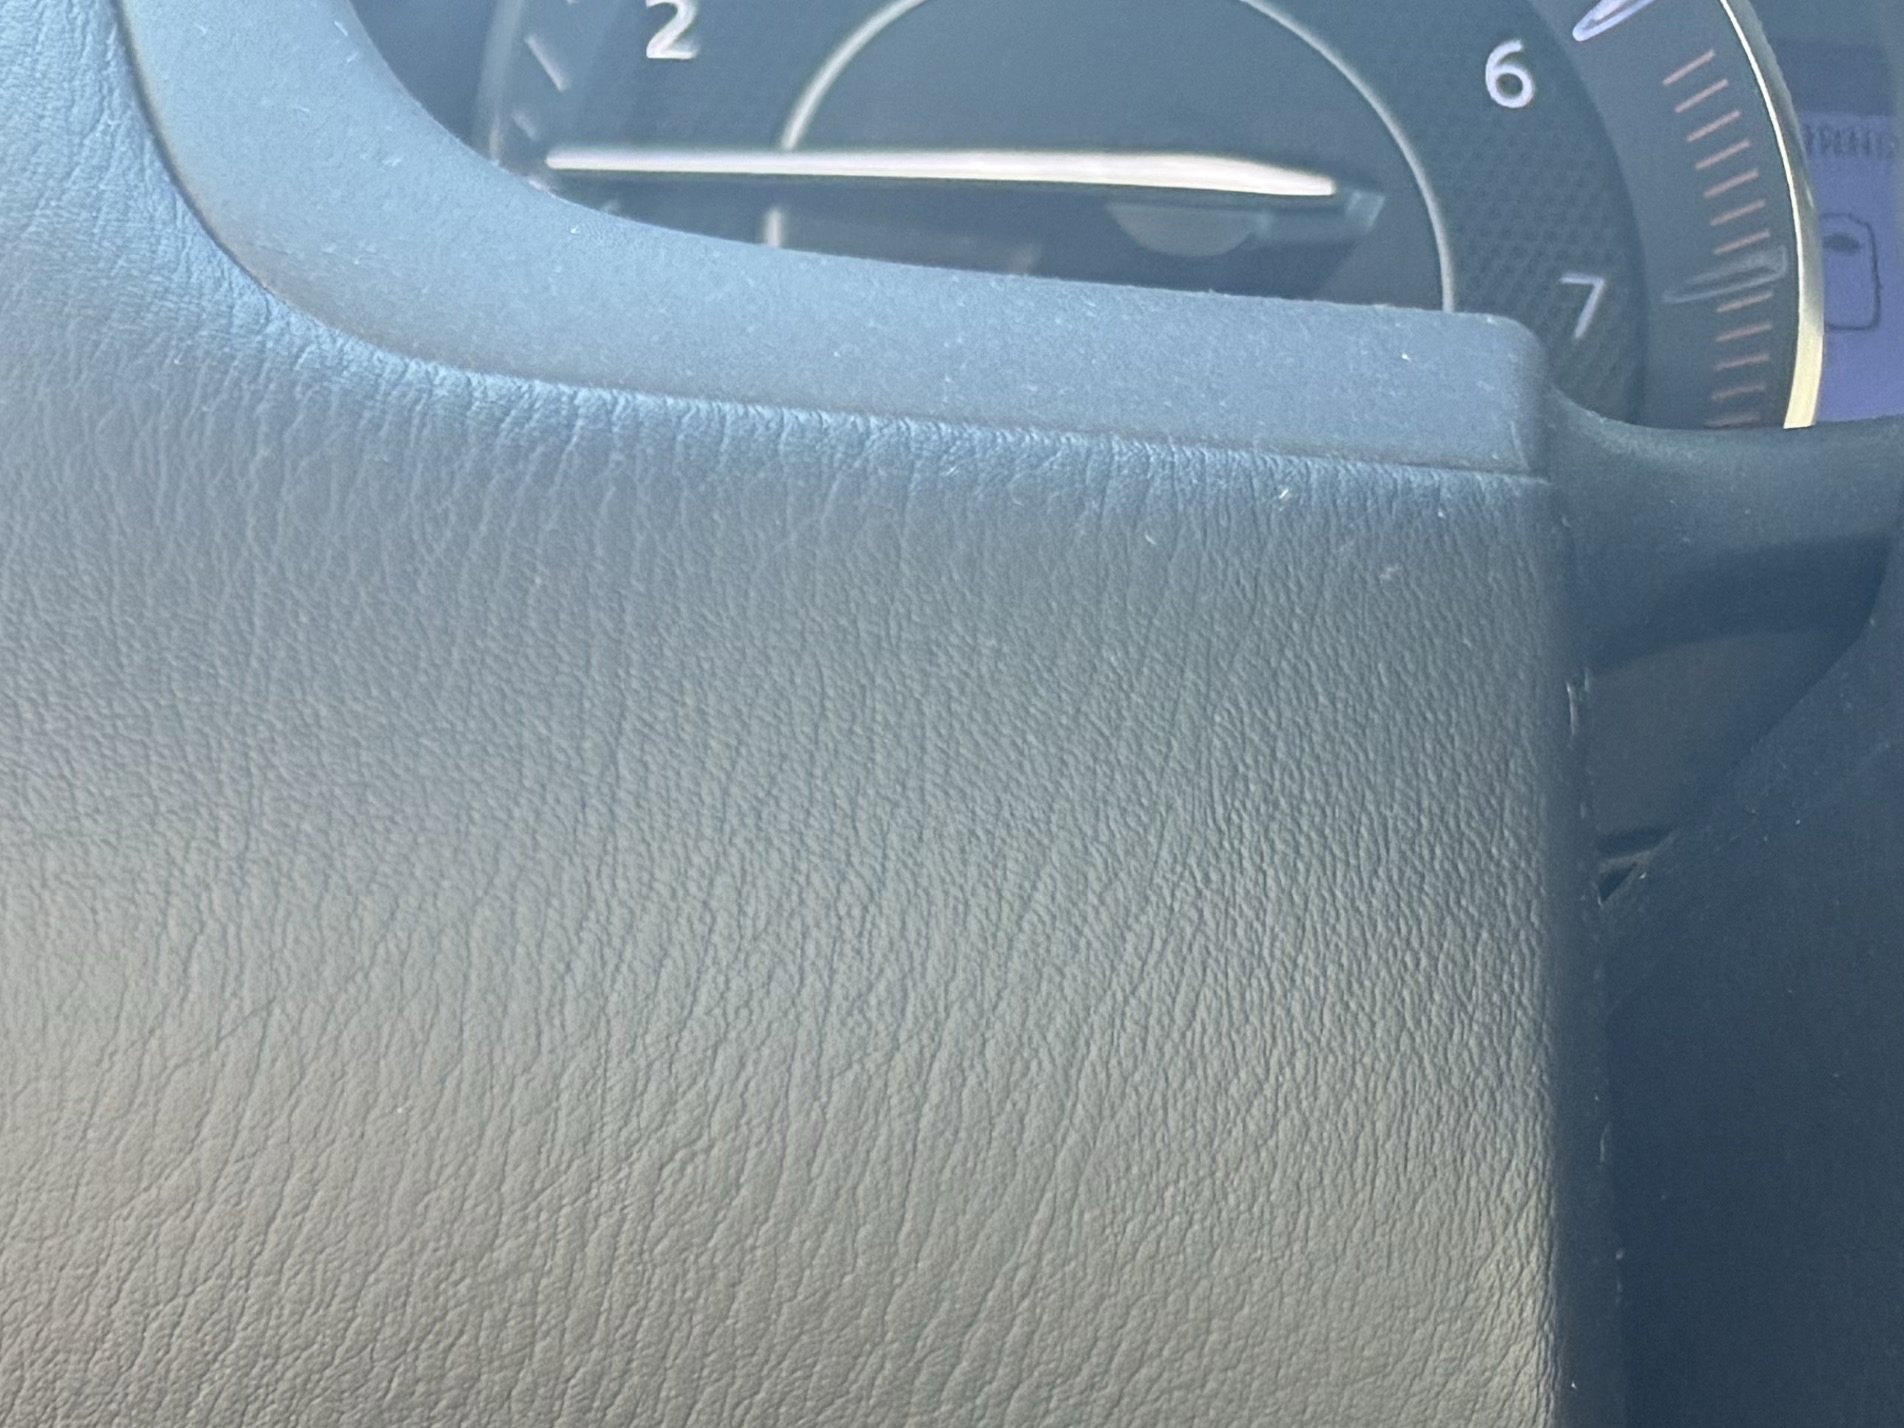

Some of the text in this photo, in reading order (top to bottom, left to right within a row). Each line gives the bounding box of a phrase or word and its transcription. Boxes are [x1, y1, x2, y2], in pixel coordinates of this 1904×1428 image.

[645, 0, 698, 60] 2
[1485, 38, 1536, 109] 6
[1559, 269, 1606, 340] 7
